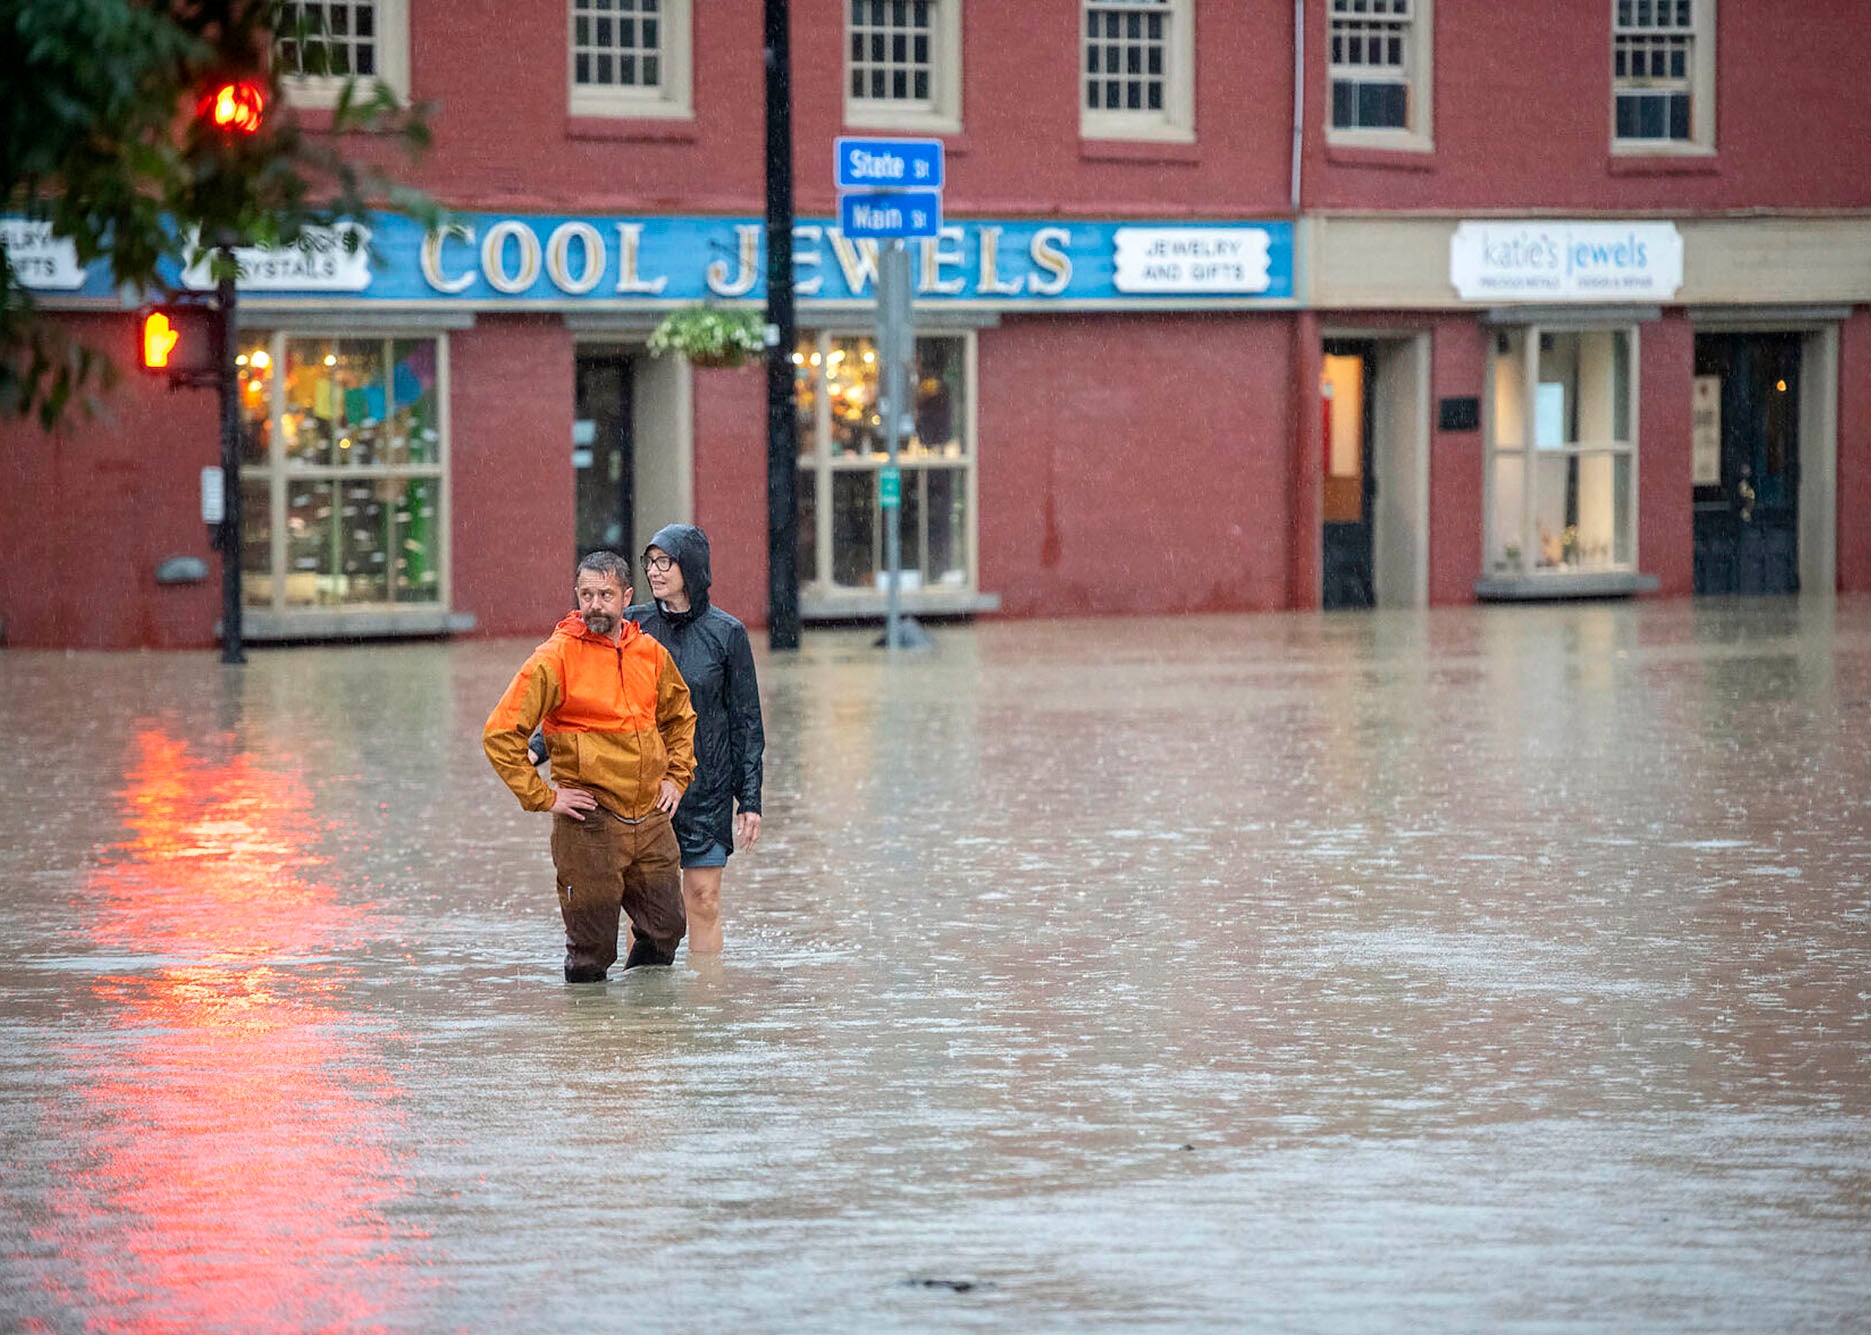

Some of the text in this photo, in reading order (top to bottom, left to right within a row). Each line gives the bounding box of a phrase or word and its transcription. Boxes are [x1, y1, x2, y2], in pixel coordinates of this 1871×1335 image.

[849, 149, 930, 178] State St
[852, 204, 927, 229] Main St
[420, 220, 1073, 297] COOL JEWELS
[1145, 239, 1242, 256] JEWELRY
[1482, 230, 1648, 277] katie's jewels
[1143, 263, 1246, 281] AND GIFTS
